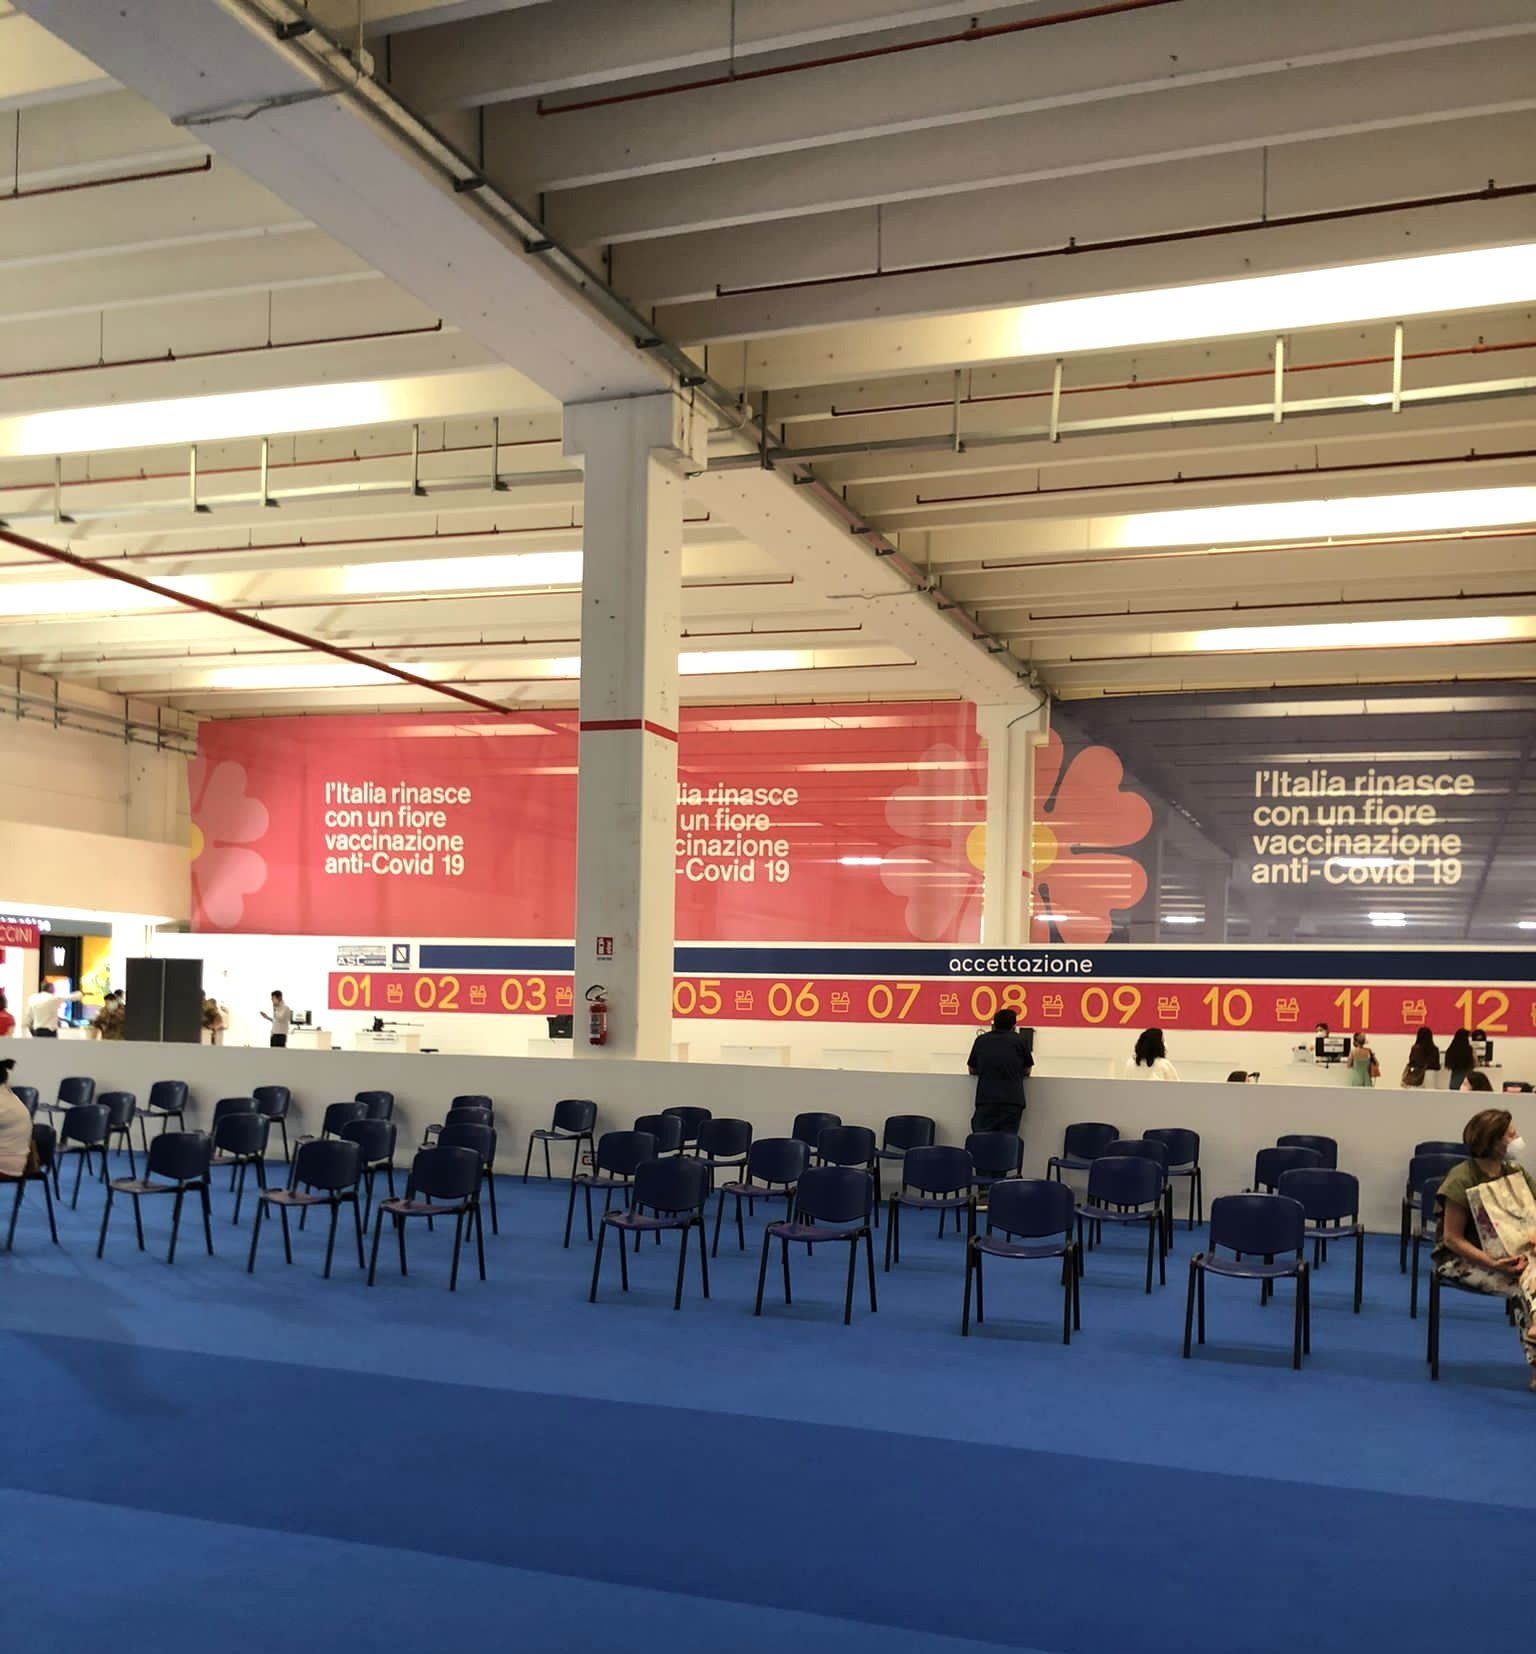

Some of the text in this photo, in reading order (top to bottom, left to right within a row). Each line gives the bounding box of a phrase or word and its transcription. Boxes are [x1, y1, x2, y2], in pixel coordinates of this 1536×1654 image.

[325, 780, 472, 804] l'Italia rinasce
[707, 782, 799, 806] rinasce
[1255, 768, 1475, 798] l'Italia rinasce
[324, 805, 447, 828] con un fiore
[680, 807, 770, 831] un fiore
[1253, 798, 1437, 827] con un fiore
[324, 828, 465, 852] vaccinazione
[1252, 828, 1462, 855] vaccinazione
[324, 852, 465, 876] anti-Covid 19
[764, 859, 790, 883] 19
[1251, 857, 1462, 884] anti-Covid 19
[949, 954, 1093, 973] accettazione
[337, 974, 1509, 1032] 01 02 03 05 06 07 08 09 10 11 12
